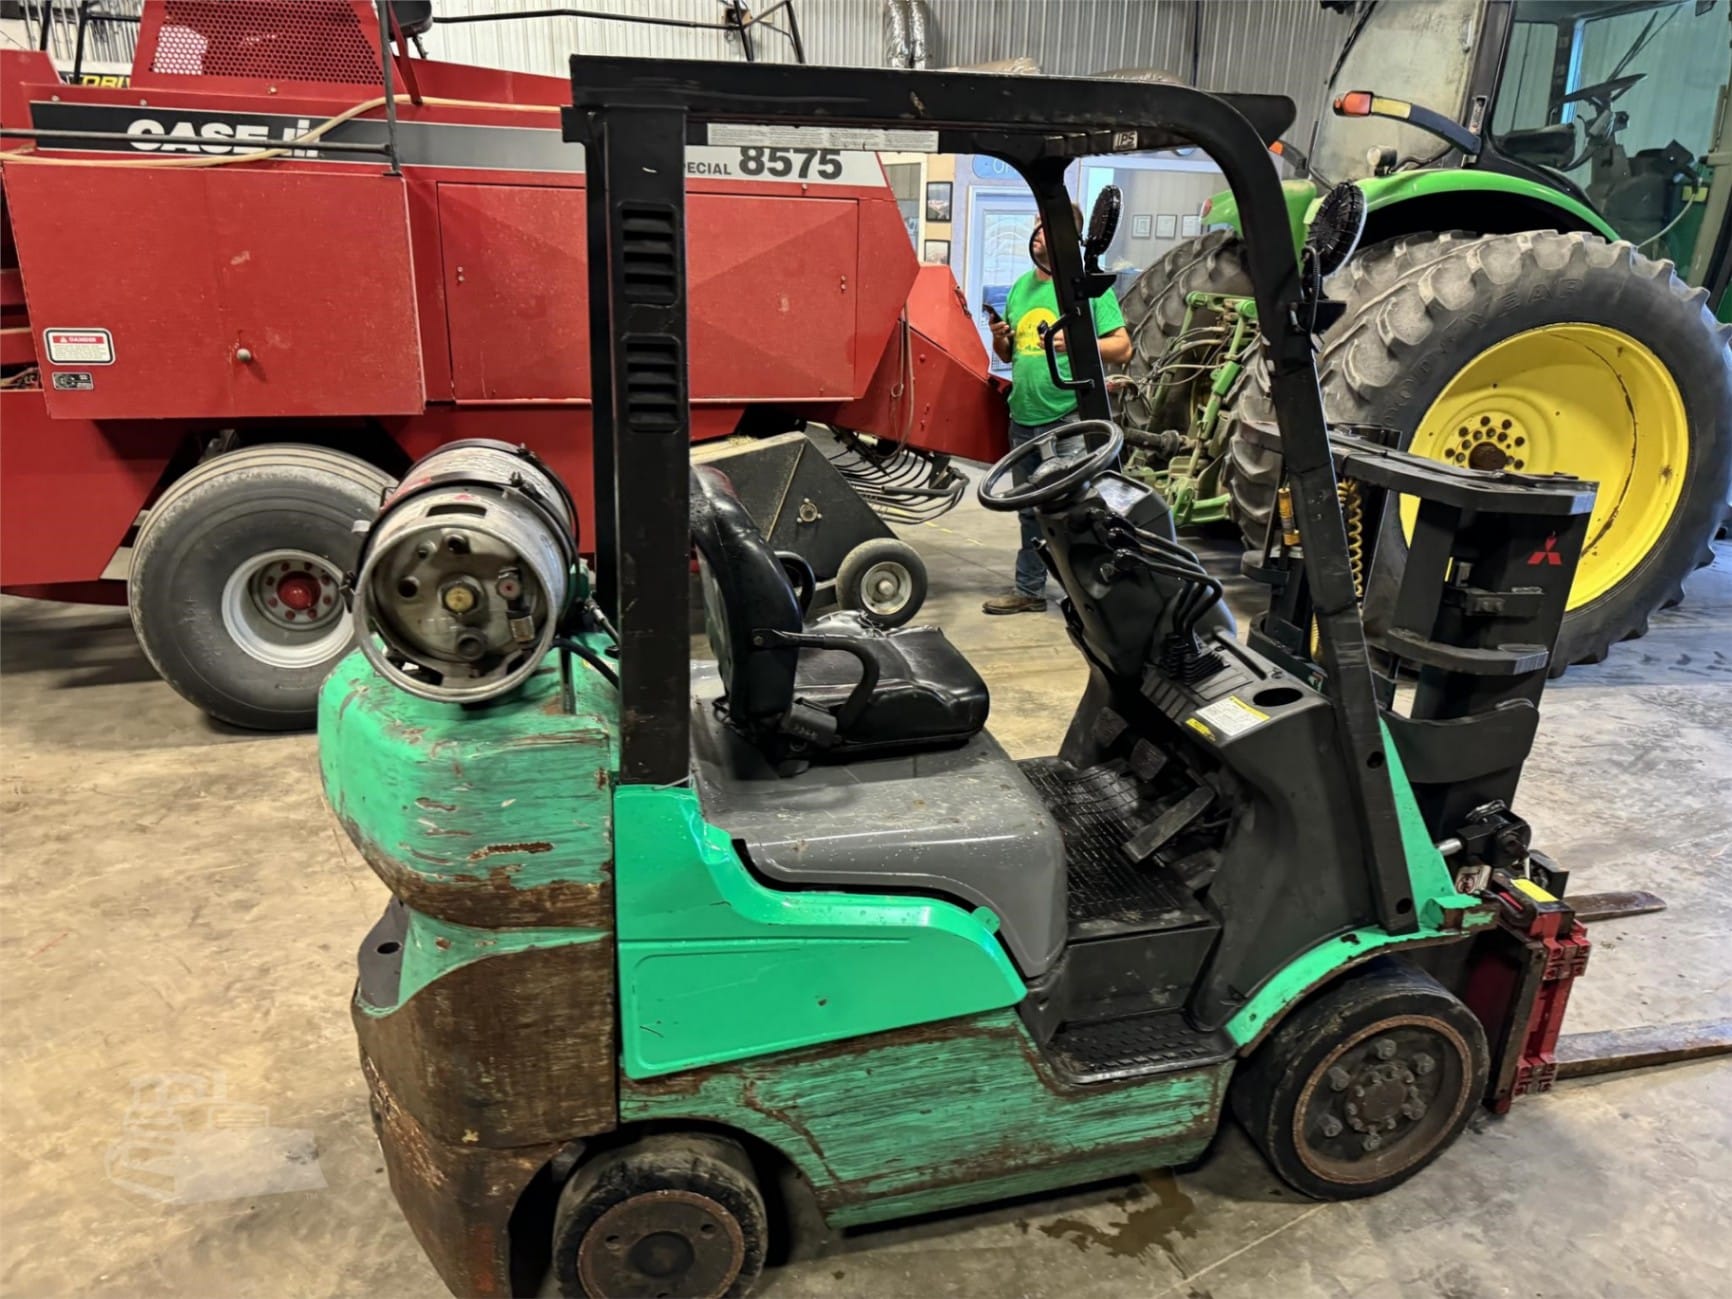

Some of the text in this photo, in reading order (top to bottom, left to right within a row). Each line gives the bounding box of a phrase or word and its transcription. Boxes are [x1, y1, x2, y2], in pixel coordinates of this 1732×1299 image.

[127, 119, 269, 154] CASE
[684, 147, 842, 179] ECIAL 8575
